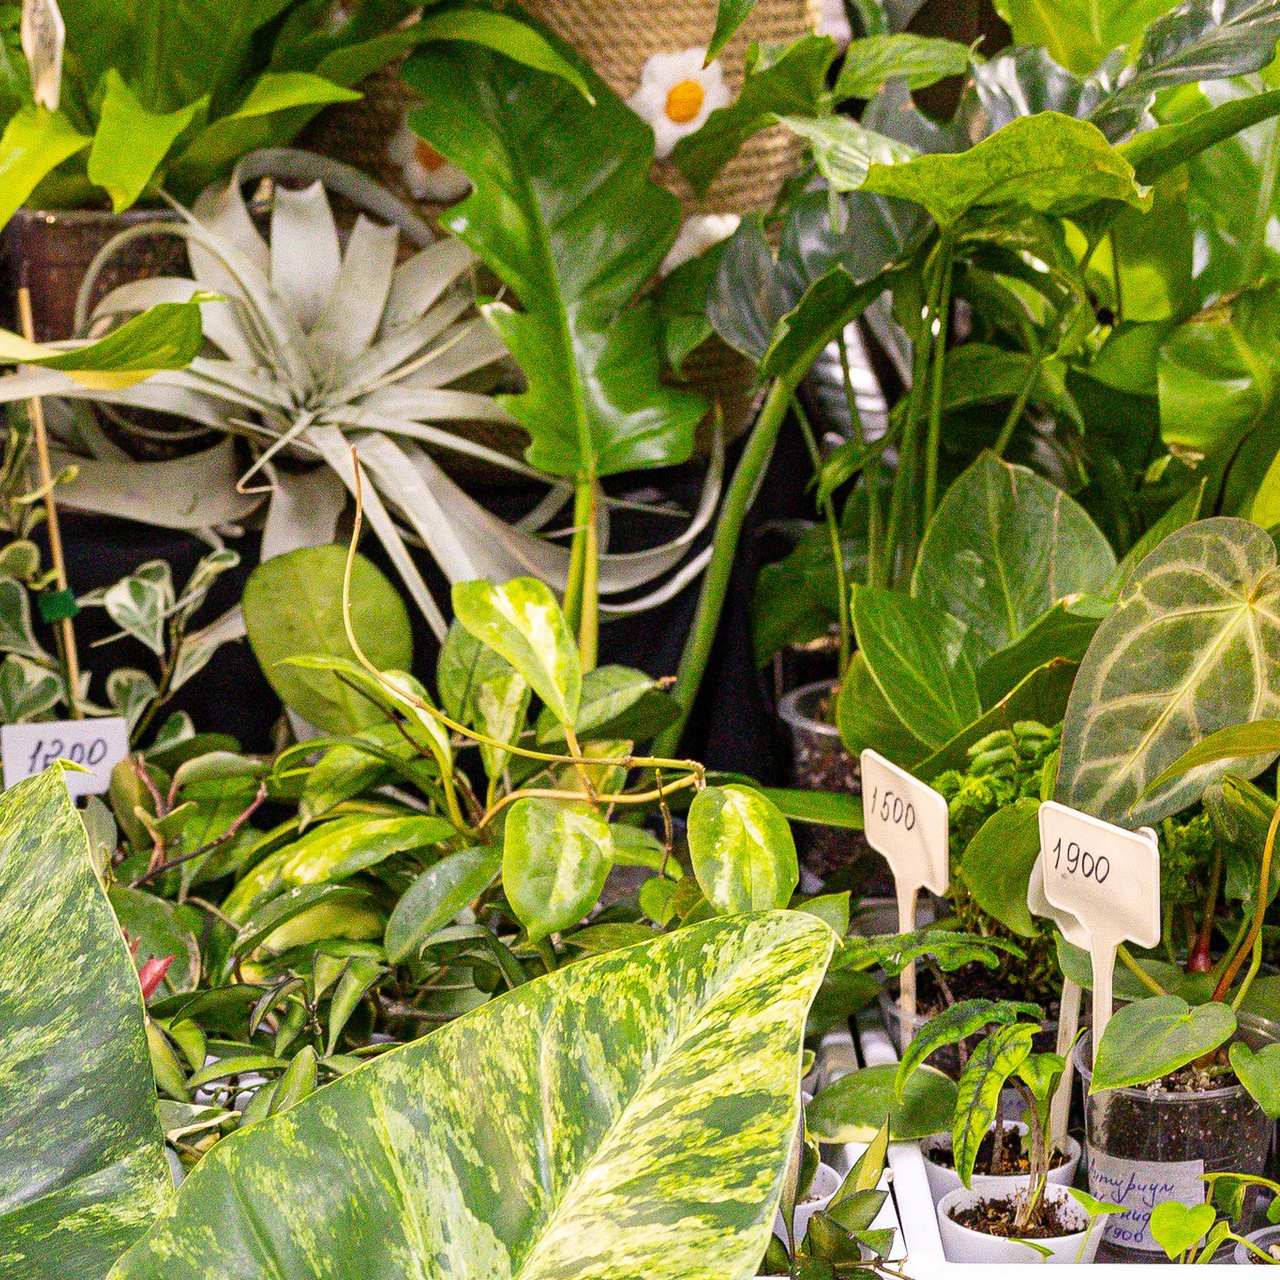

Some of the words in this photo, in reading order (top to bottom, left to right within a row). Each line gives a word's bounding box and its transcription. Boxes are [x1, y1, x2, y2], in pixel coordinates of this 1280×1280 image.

[29, 738, 108, 773] 1200
[871, 786, 916, 831] 1500
[1052, 837, 1110, 884] 1900
